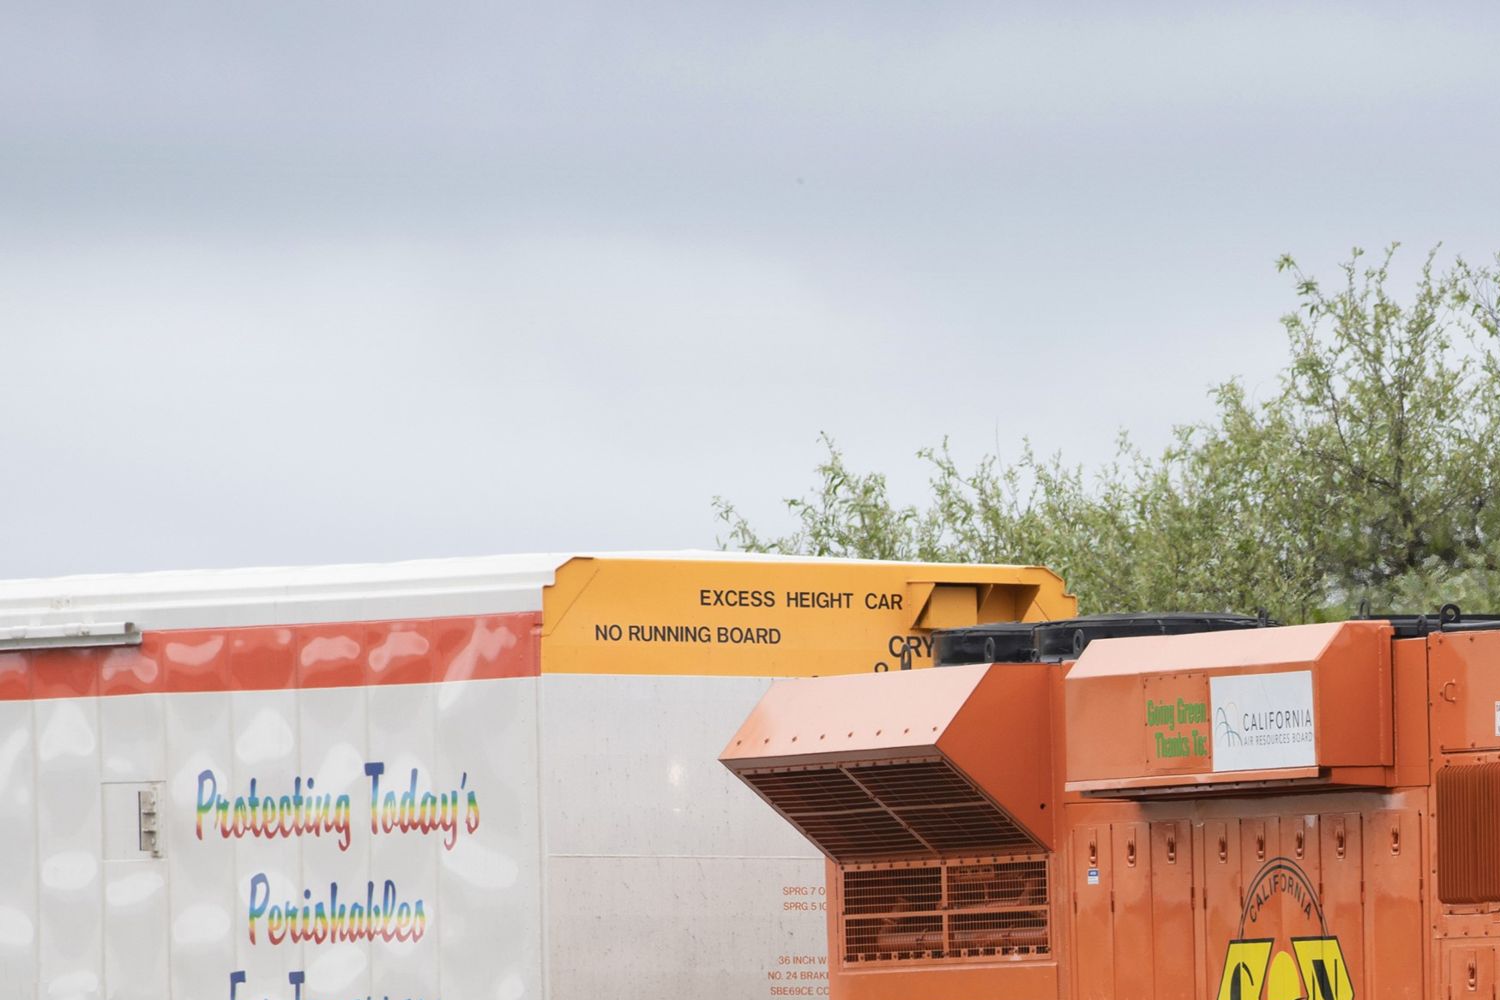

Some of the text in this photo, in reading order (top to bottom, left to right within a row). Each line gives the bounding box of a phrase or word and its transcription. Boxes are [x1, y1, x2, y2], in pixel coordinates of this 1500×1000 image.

[700, 589, 904, 610] EXCESS HEIGHT CAR
[595, 624, 782, 645] NO RUNNING BOARD
[1146, 698, 1207, 731] Going Green
[1242, 709, 1313, 732] CALIFORNIA
[1155, 732, 1191, 758] Thanks
[1243, 731, 1313, 746] AIR RESOURCES BOARD
[196, 762, 480, 852] Protecting Today's
[782, 886, 808, 895] SPRG
[811, 886, 816, 895] 7
[1249, 873, 1312, 923] CALIFORNIA
[249, 872, 426, 946] Perishables
[783, 902, 808, 911] SPRG
[811, 902, 817, 911] 5
[778, 956, 791, 965] 36
[793, 956, 816, 965] INCH
[786, 971, 798, 980] 24
